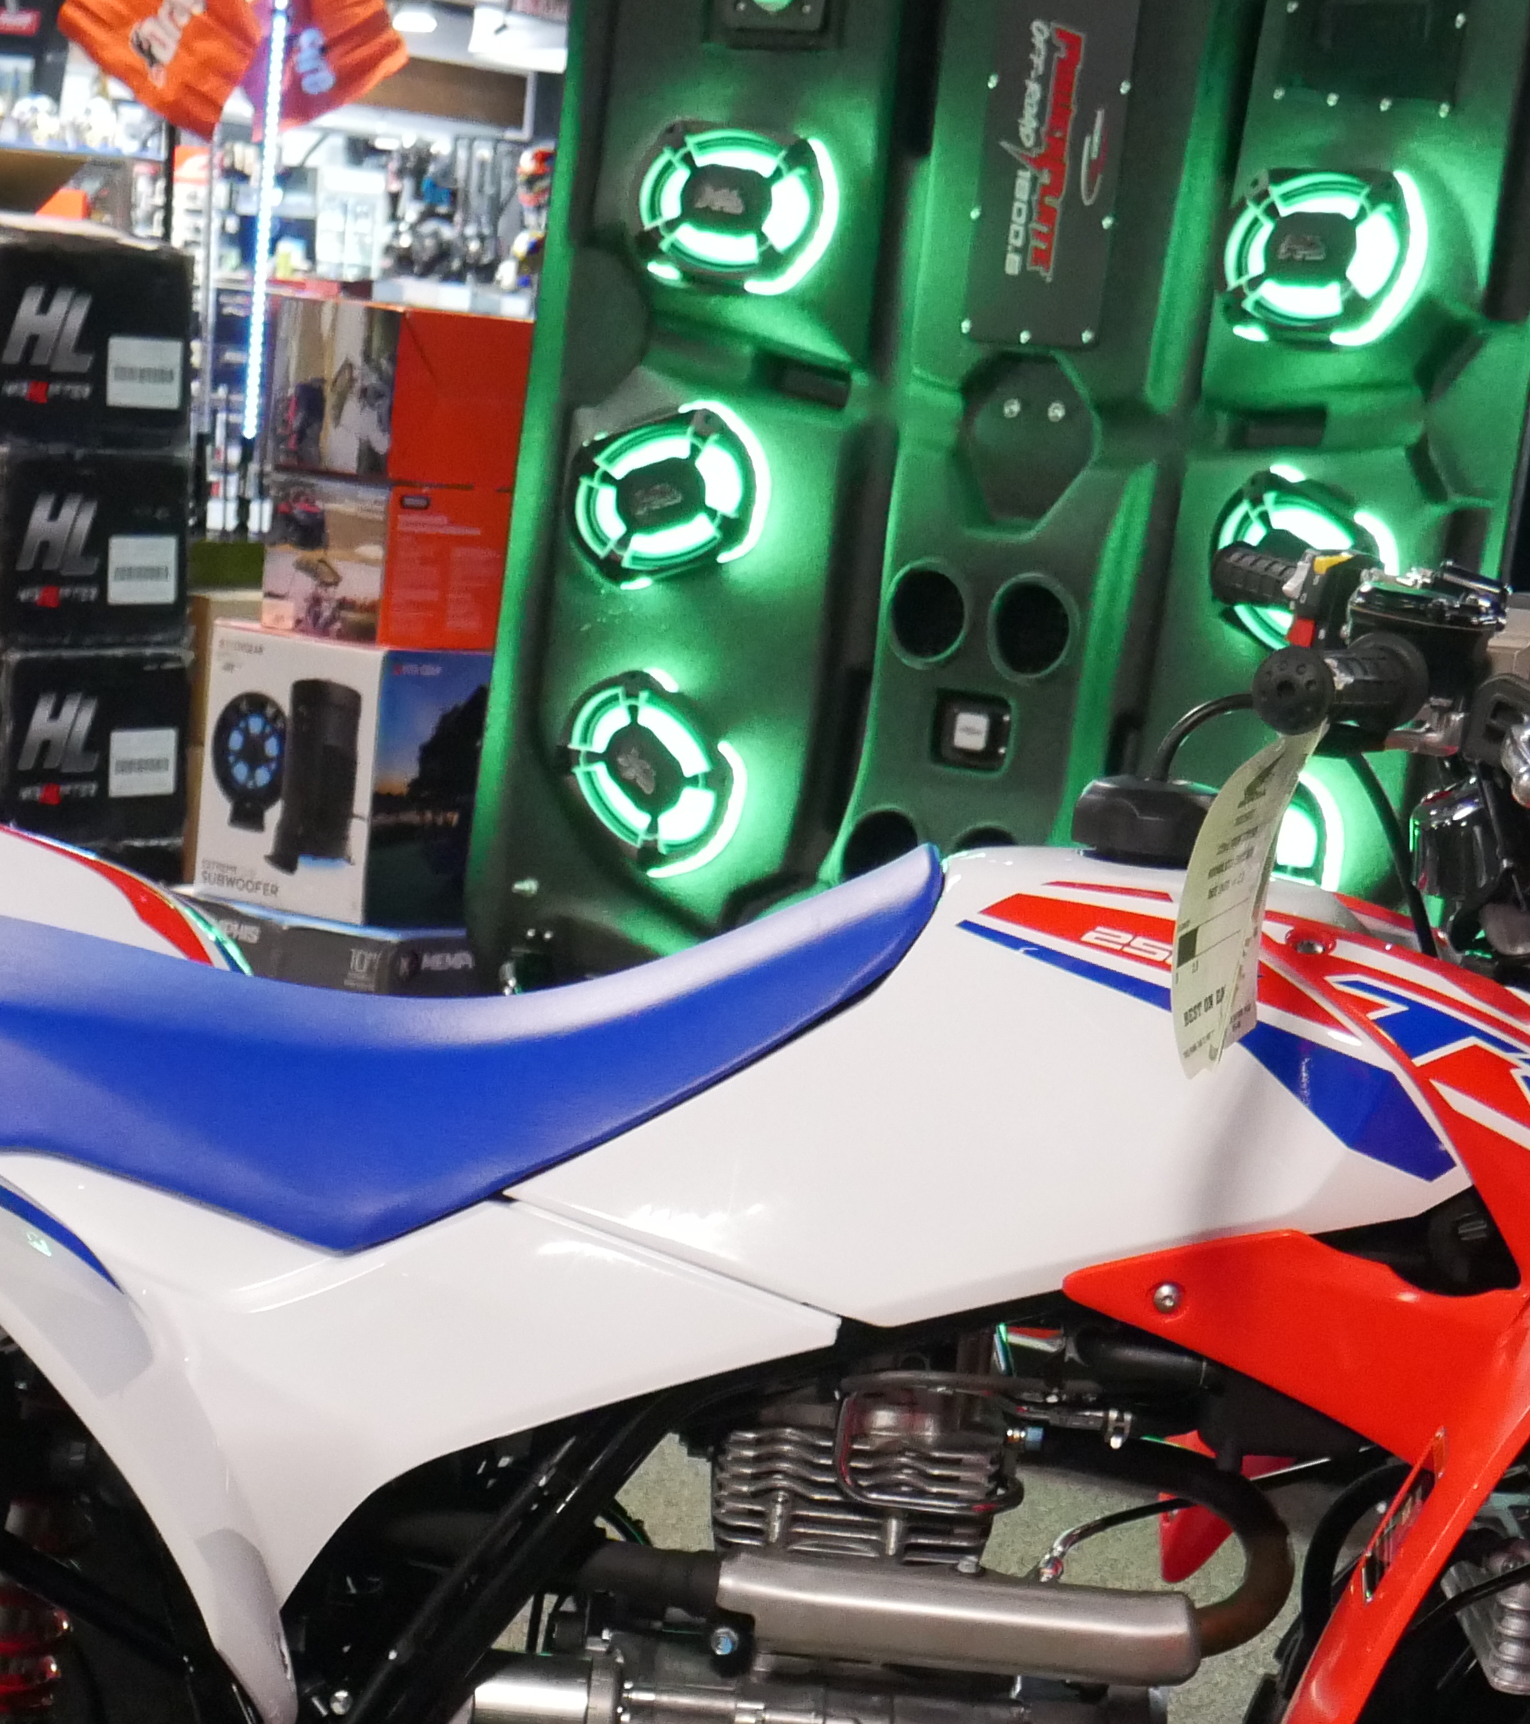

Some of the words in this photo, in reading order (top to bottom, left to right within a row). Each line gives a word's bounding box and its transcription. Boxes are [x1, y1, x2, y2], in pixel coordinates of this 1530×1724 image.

[1, 285, 94, 374] HL
[15, 492, 99, 576] HL
[17, 692, 99, 773] HL
[201, 870, 280, 897] SUBWOOFER
[1080, 926, 1173, 966] 25
